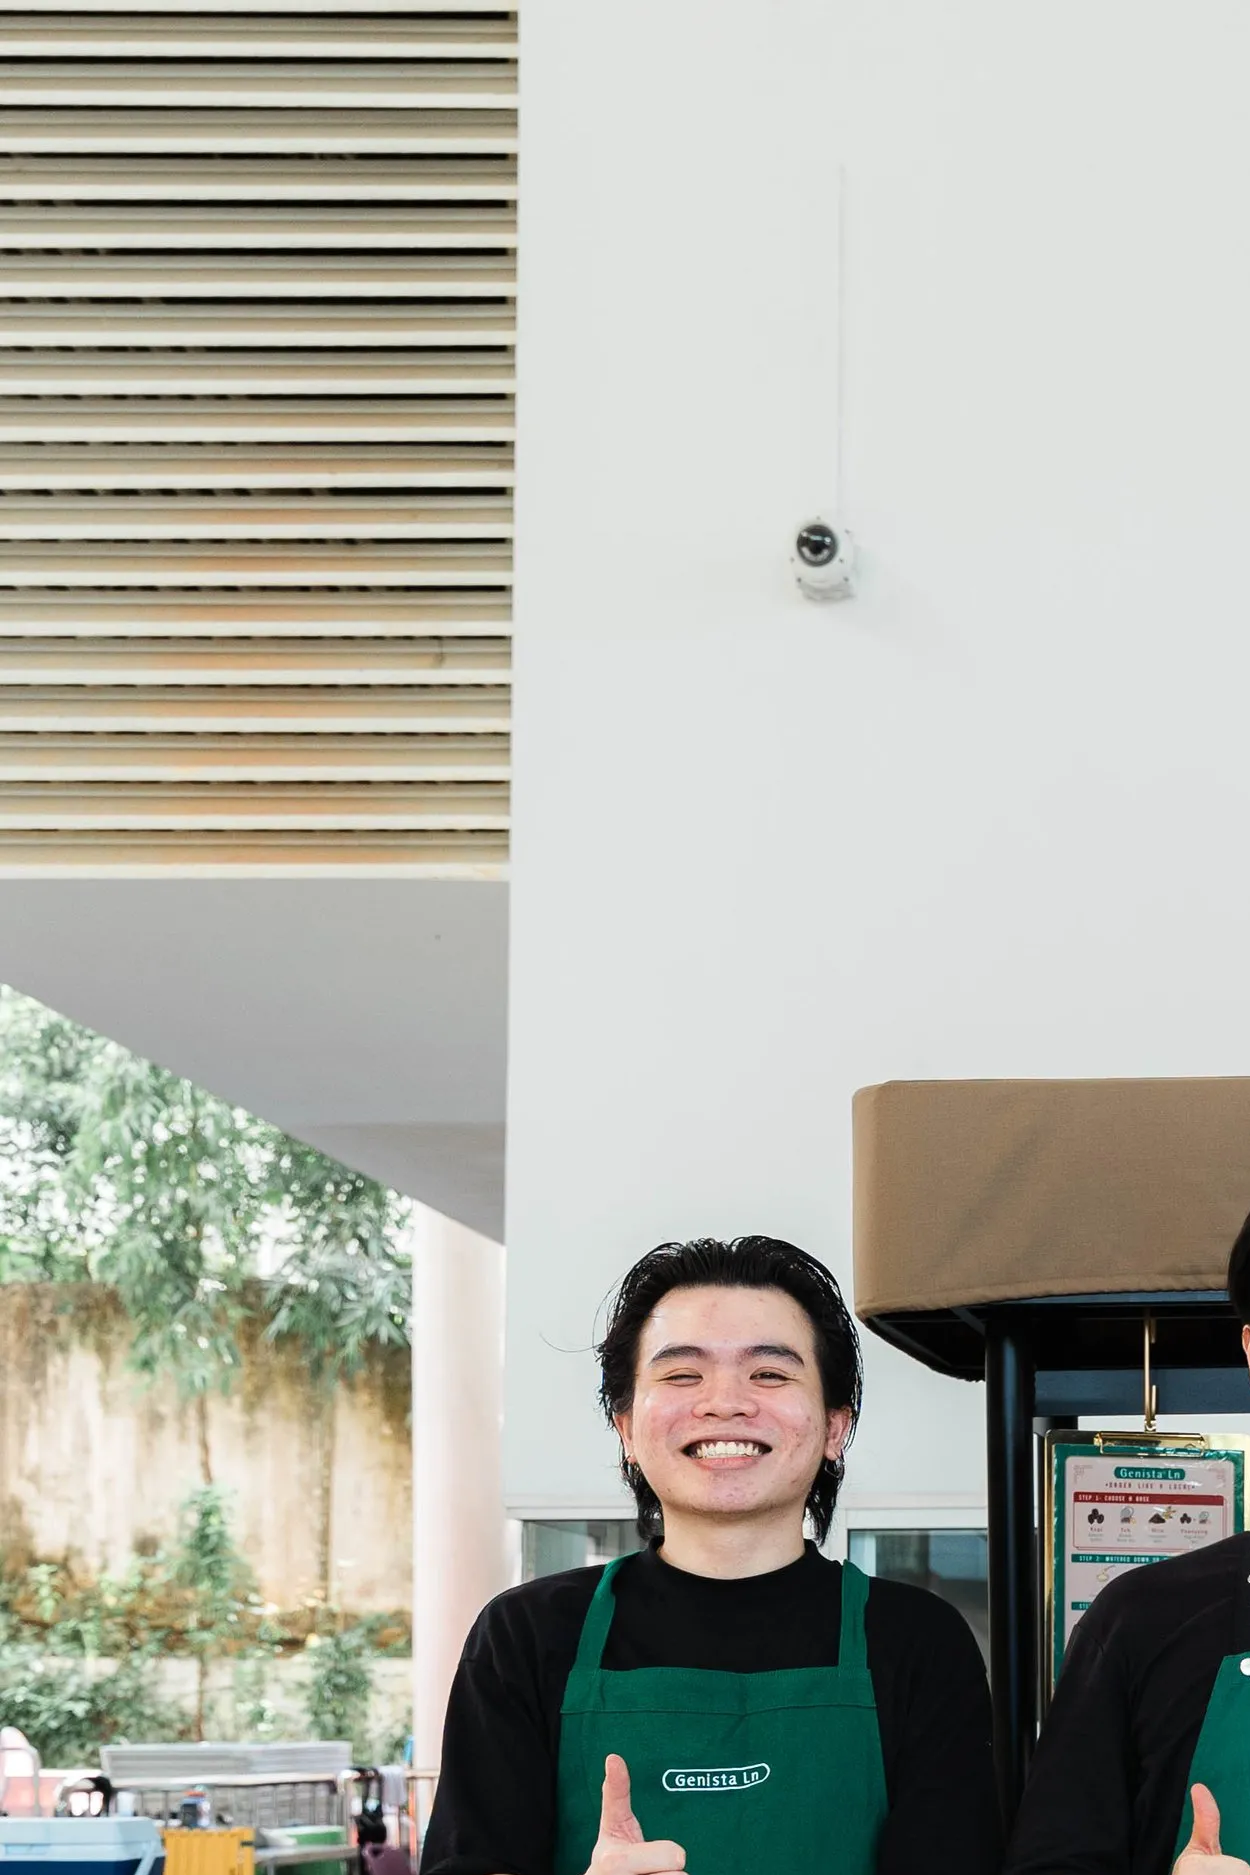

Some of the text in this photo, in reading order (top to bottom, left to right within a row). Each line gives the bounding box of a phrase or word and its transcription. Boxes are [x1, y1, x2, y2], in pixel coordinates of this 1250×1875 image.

[1119, 1468, 1180, 1479] Genista Ln
[675, 1771, 759, 1787] Genista Ln
